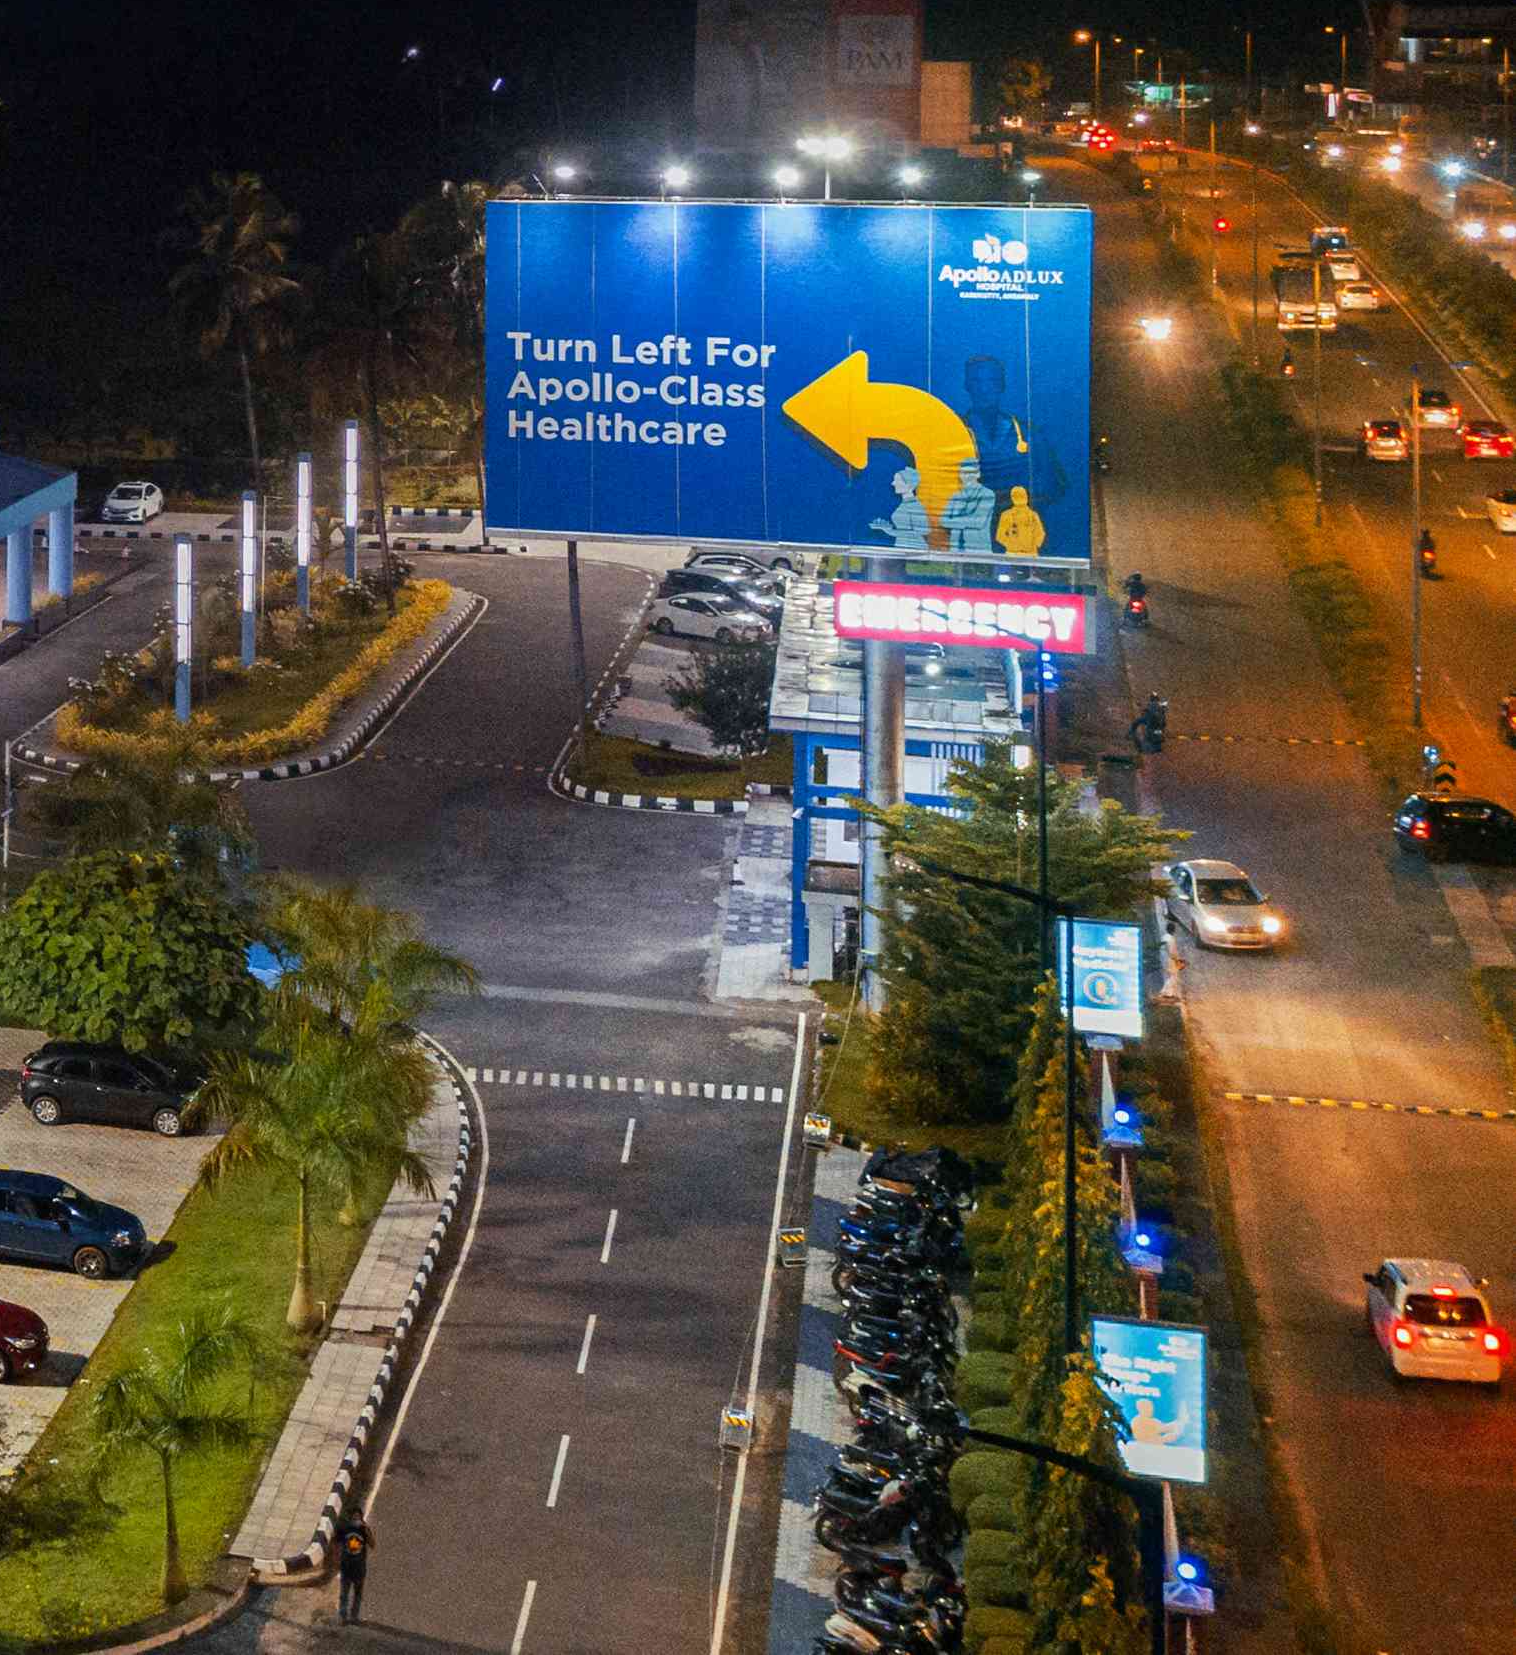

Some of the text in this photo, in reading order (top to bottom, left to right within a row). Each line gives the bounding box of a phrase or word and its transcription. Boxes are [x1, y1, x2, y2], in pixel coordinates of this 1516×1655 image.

[976, 283, 1024, 292] HOSPITAL
[1001, 270, 1064, 284] ADLUX
[507, 332, 777, 368] Turn Left For
[507, 371, 767, 407] Apollo-Class
[508, 409, 727, 446] Healthcare
[838, 593, 1076, 642] EMERGENCY
